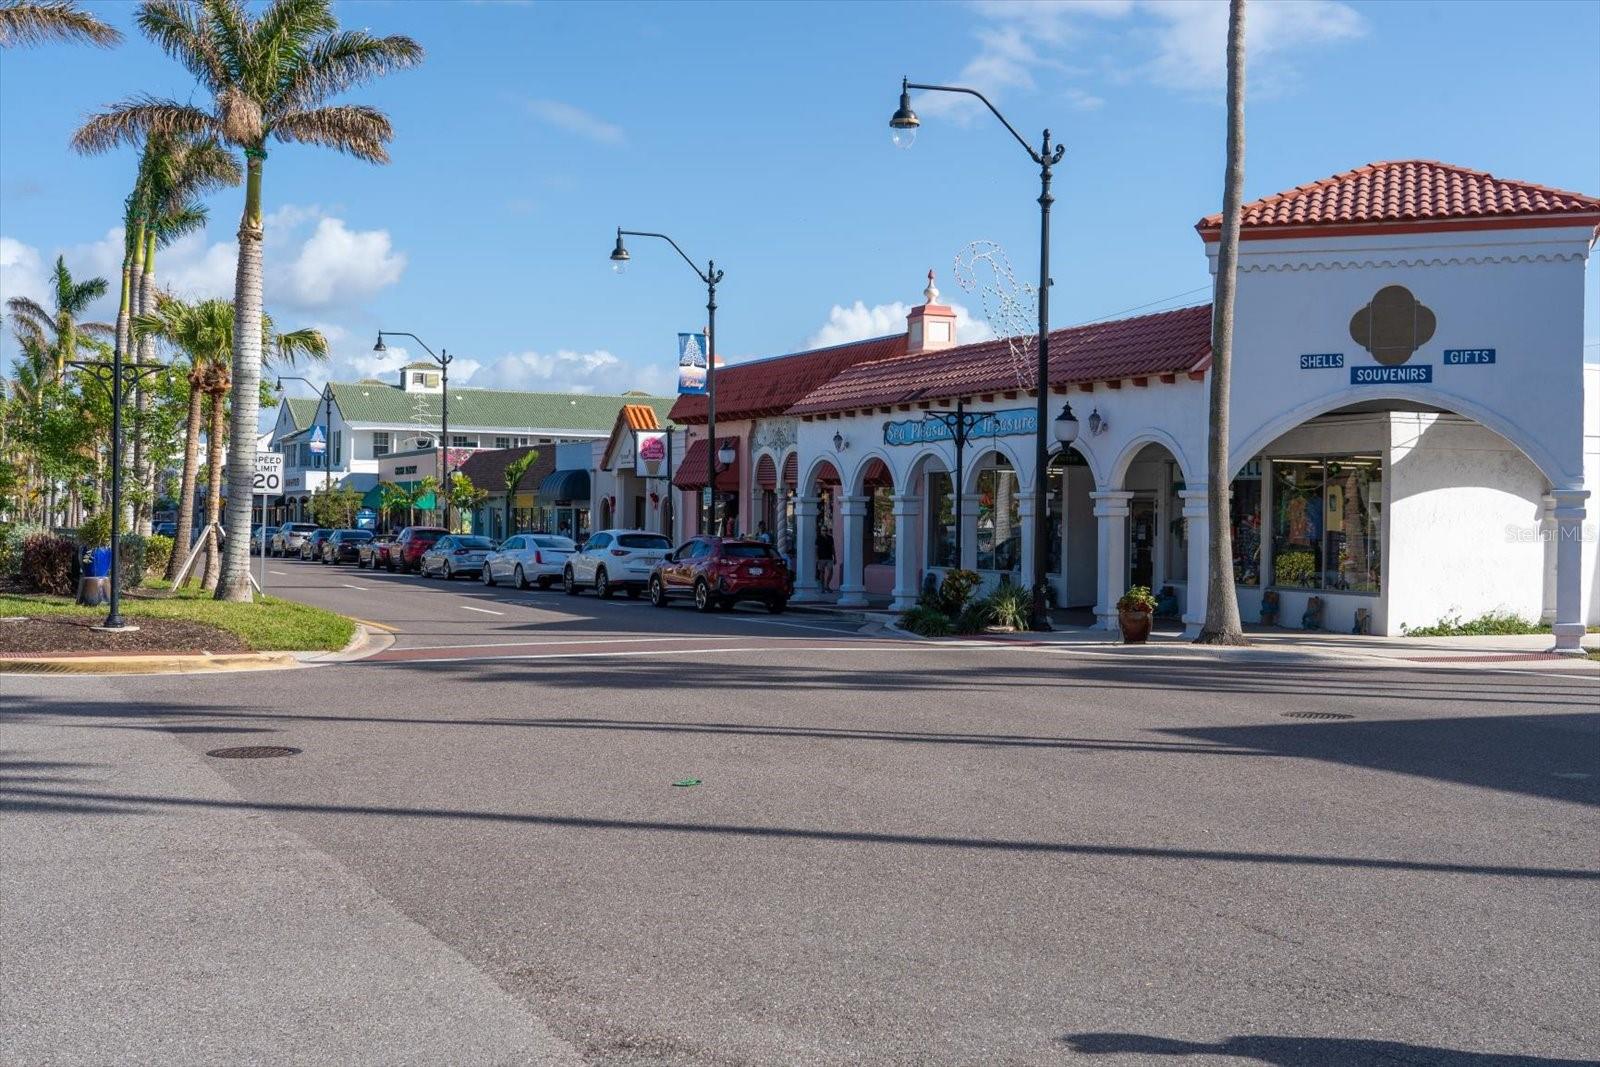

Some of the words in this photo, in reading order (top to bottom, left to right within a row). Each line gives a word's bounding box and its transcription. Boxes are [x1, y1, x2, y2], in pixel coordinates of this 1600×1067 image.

[1300, 354, 1344, 368] SHELLS
[1449, 350, 1490, 364] GIFTS
[1356, 368, 1427, 382] SOUVENIRS
[888, 425, 905, 441] Sea
[911, 421, 953, 439] Pleasu
[255, 456, 282, 464] PEED
[253, 473, 279, 489] 20
